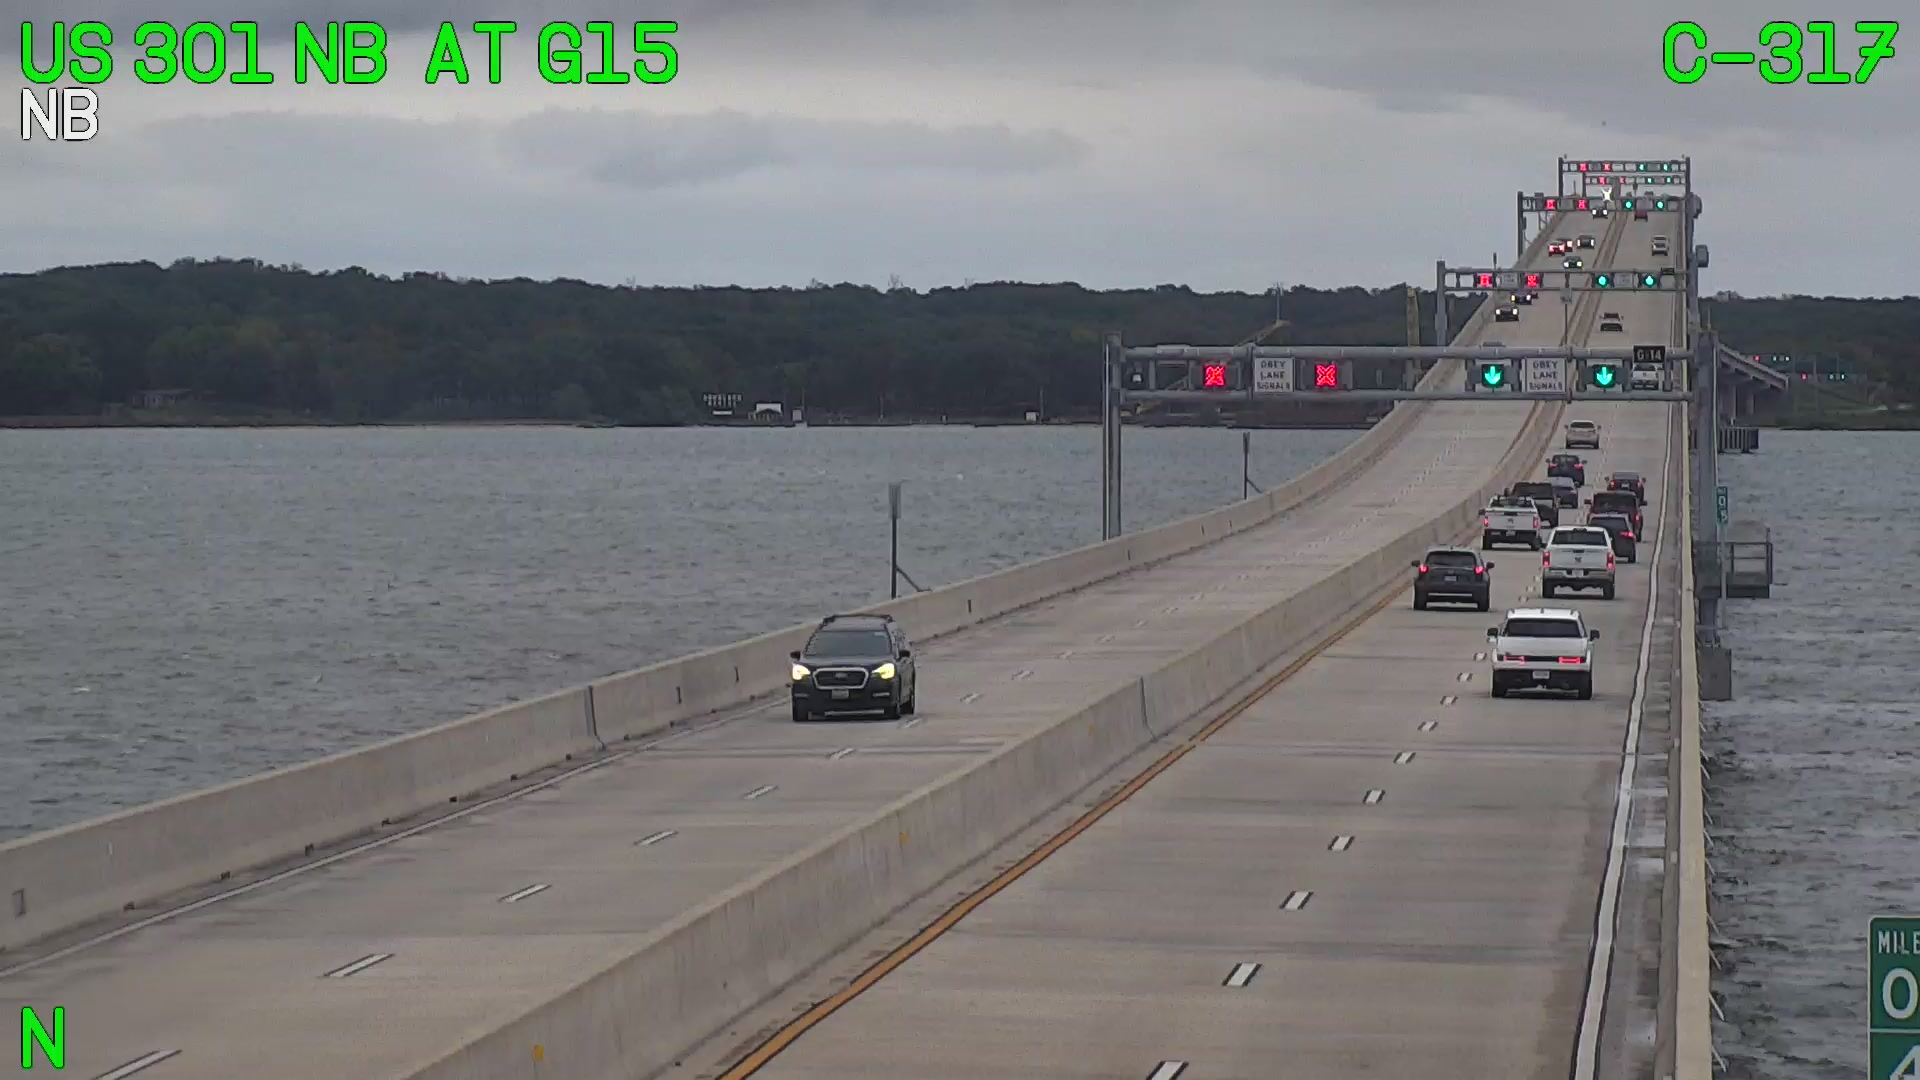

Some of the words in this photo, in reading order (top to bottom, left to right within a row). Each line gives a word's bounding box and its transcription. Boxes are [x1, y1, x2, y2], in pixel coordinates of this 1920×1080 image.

[1261, 371, 1285, 379] LANE
[1533, 371, 1557, 380] LANE
[1882, 967, 1919, 1020] 0
